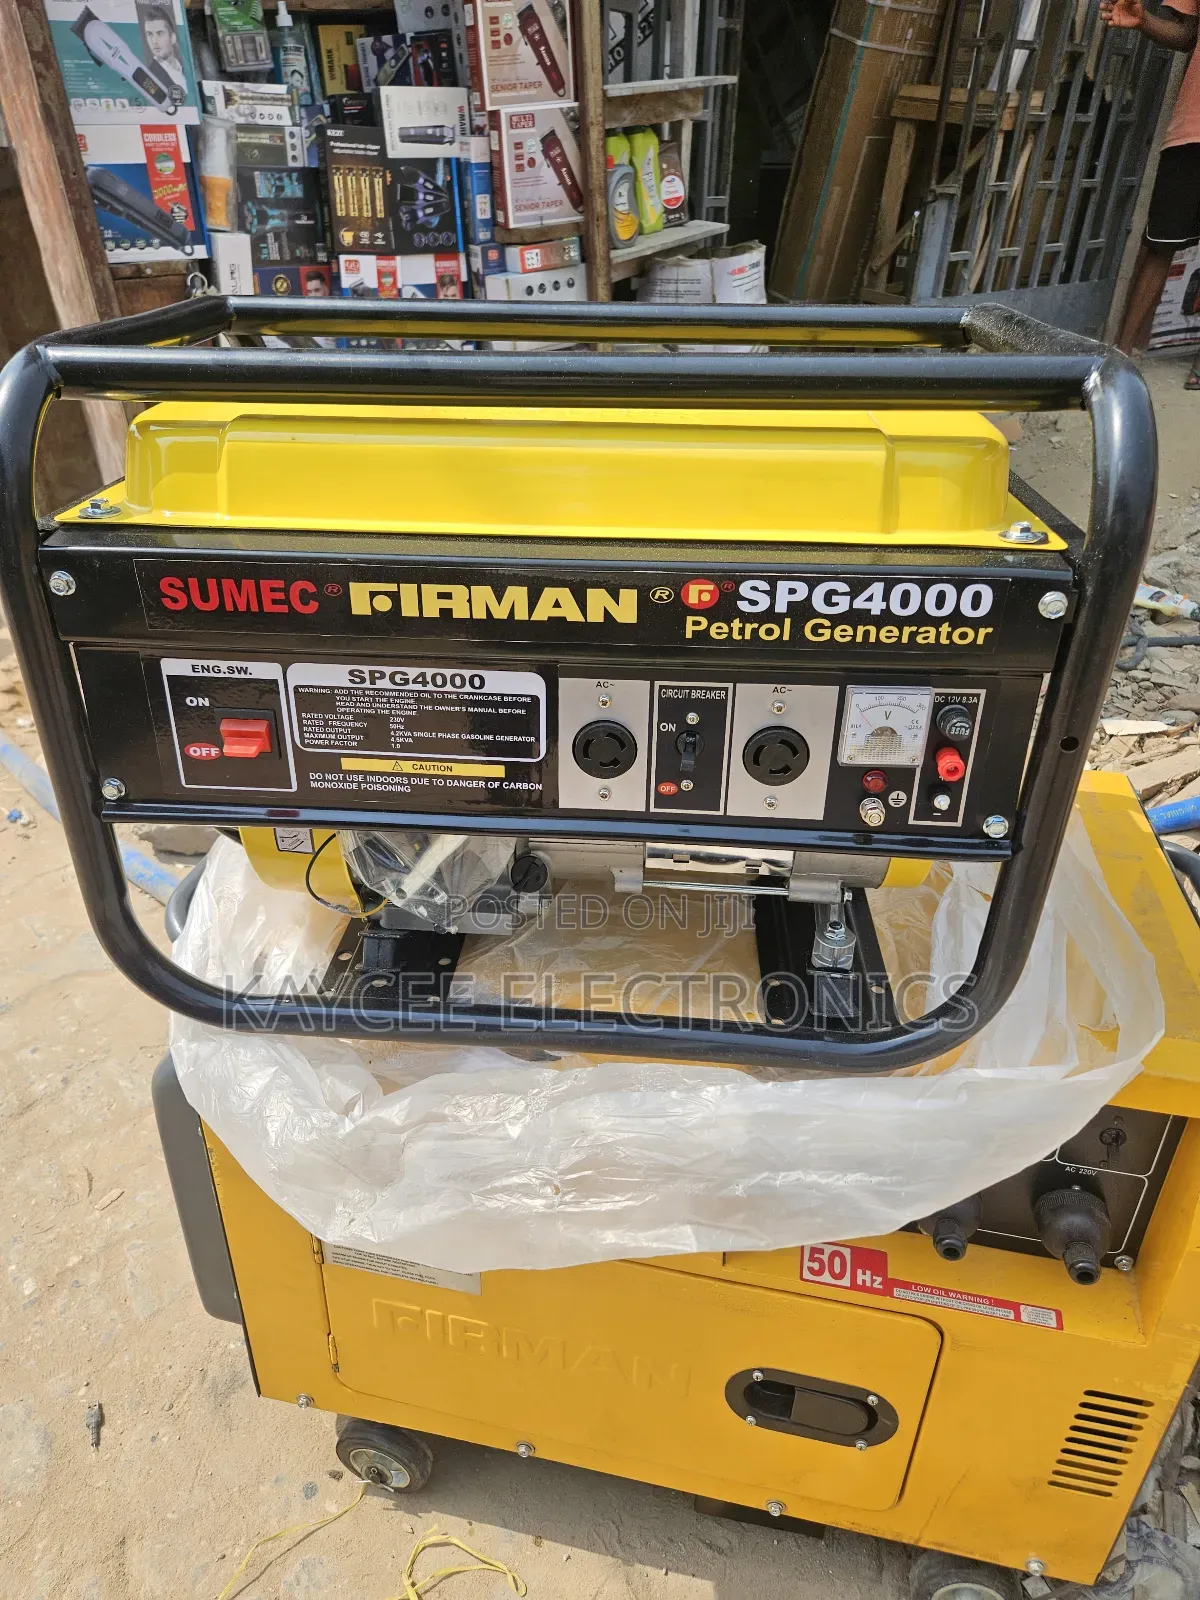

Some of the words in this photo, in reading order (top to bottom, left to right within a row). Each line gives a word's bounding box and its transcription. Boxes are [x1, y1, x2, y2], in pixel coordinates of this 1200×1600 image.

[490, 82, 518, 93] SENIOR
[519, 81, 543, 89] TAPER
[512, 121, 534, 129] TAPER
[514, 201, 540, 212] SENIOR
[542, 199, 564, 208] TAPER
[159, 576, 319, 614] SUMEC
[737, 579, 994, 618] SPG4000
[349, 582, 638, 623] FIRMAN
[685, 616, 791, 641] Petrol
[803, 618, 993, 645] Generator
[191, 664, 253, 675] ENG.SW.
[348, 668, 486, 690] SPG4000
[365, 690, 419, 698] RECOMMENDED
[460, 694, 502, 702] CRANKCASE
[661, 688, 690, 699] CIRCUIT
[691, 690, 726, 700] BREAKER
[962, 696, 978, 704] 8.3A
[185, 696, 210, 707] ON
[884, 710, 892, 720] V
[328, 720, 368, 728] FREQUENCY
[660, 722, 676, 732] ON
[950, 726, 970, 736] FUSE
[438, 732, 460, 740] PHASE
[496, 735, 536, 743] GENERATOR
[189, 746, 220, 757] OFF
[412, 764, 453, 772] CAUTION
[309, 772, 323, 780] DO
[346, 774, 365, 782] USE
[367, 776, 408, 784] INDOORS
[411, 778, 430, 786] DUE
[432, 778, 445, 786] TO
[446, 780, 486, 788] DANGER
[488, 781, 501, 789] OF
[502, 782, 543, 790] CARBON
[310, 781, 359, 790] MONOXIDE
[361, 783, 411, 793] POISONING
[1078, 1168, 1098, 1176] 220V
[807, 1246, 847, 1280] 50
[856, 1268, 883, 1289] Hz
[912, 1284, 931, 1294] LOW
[932, 1288, 946, 1296] OIL
[948, 1291, 990, 1305] WARNING
[372, 1298, 692, 1397] FIRMAN
